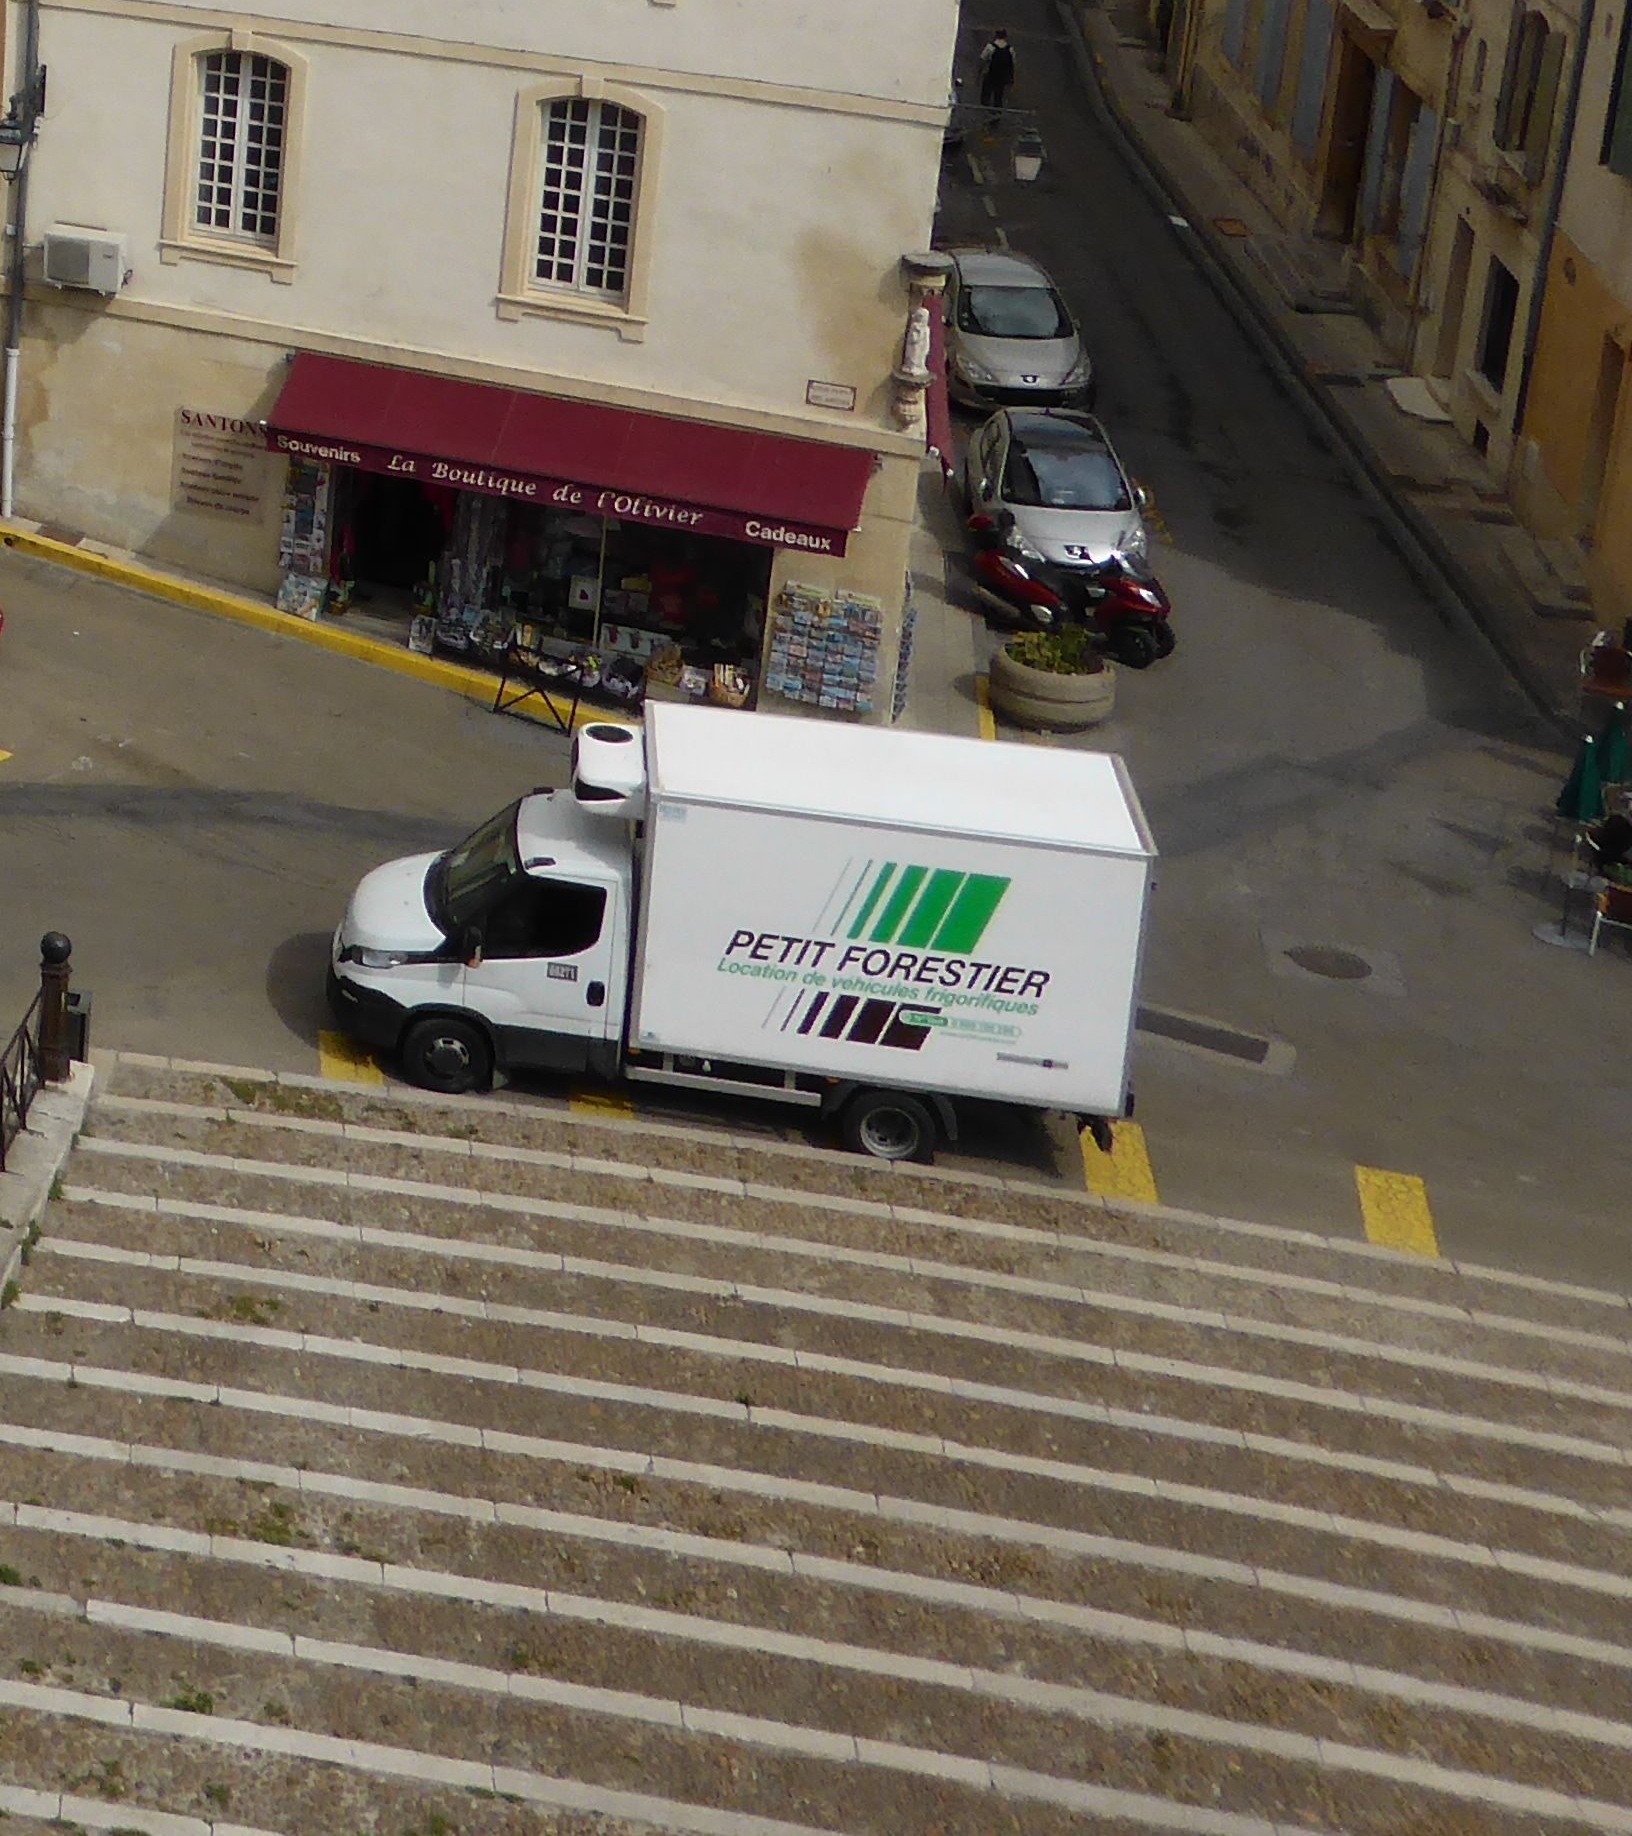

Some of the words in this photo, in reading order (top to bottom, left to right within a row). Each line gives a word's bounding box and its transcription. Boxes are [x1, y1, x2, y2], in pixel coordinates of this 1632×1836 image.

[277, 435, 361, 464] Souvenirs
[387, 454, 417, 473] La
[432, 461, 537, 496] Boutique
[551, 483, 584, 504] de
[744, 520, 832, 551] Cadeaux
[717, 957, 798, 983] Location
[802, 970, 827, 987] de
[924, 986, 1039, 1016] frigorifiques
[725, 930, 836, 967] PETIT
[837, 945, 1051, 999] FORESTIER
